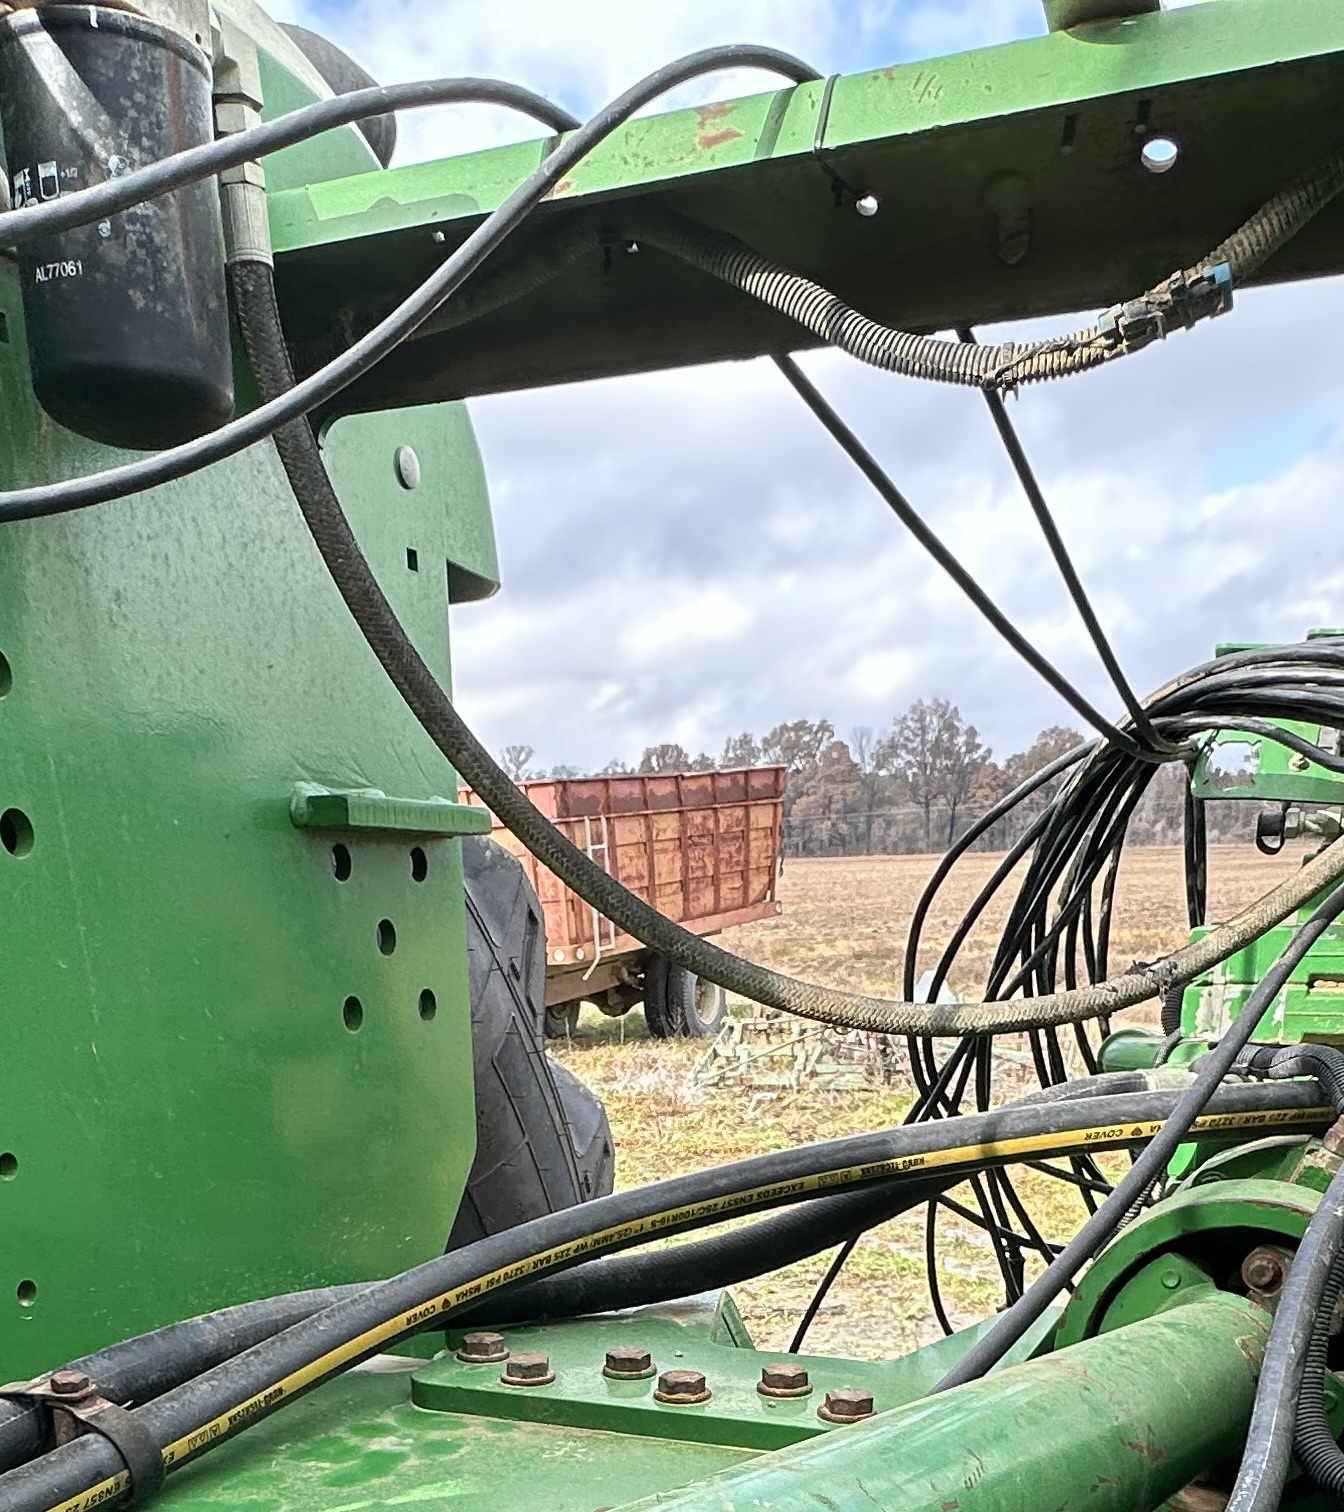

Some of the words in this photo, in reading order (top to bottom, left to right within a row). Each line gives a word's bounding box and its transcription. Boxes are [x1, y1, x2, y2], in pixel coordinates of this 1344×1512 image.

[35, 260, 83, 283] AL77061
[1084, 1128, 1124, 1141] COVER
[756, 1181, 805, 1200] EXCEEDS
[532, 1256, 552, 1270] BAR
[503, 1265, 526, 1281] 3270
[486, 1276, 502, 1290] PSI
[455, 1284, 483, 1302] MSHA
[406, 1304, 436, 1327] COVER
[82, 1480, 121, 1511] EN857
